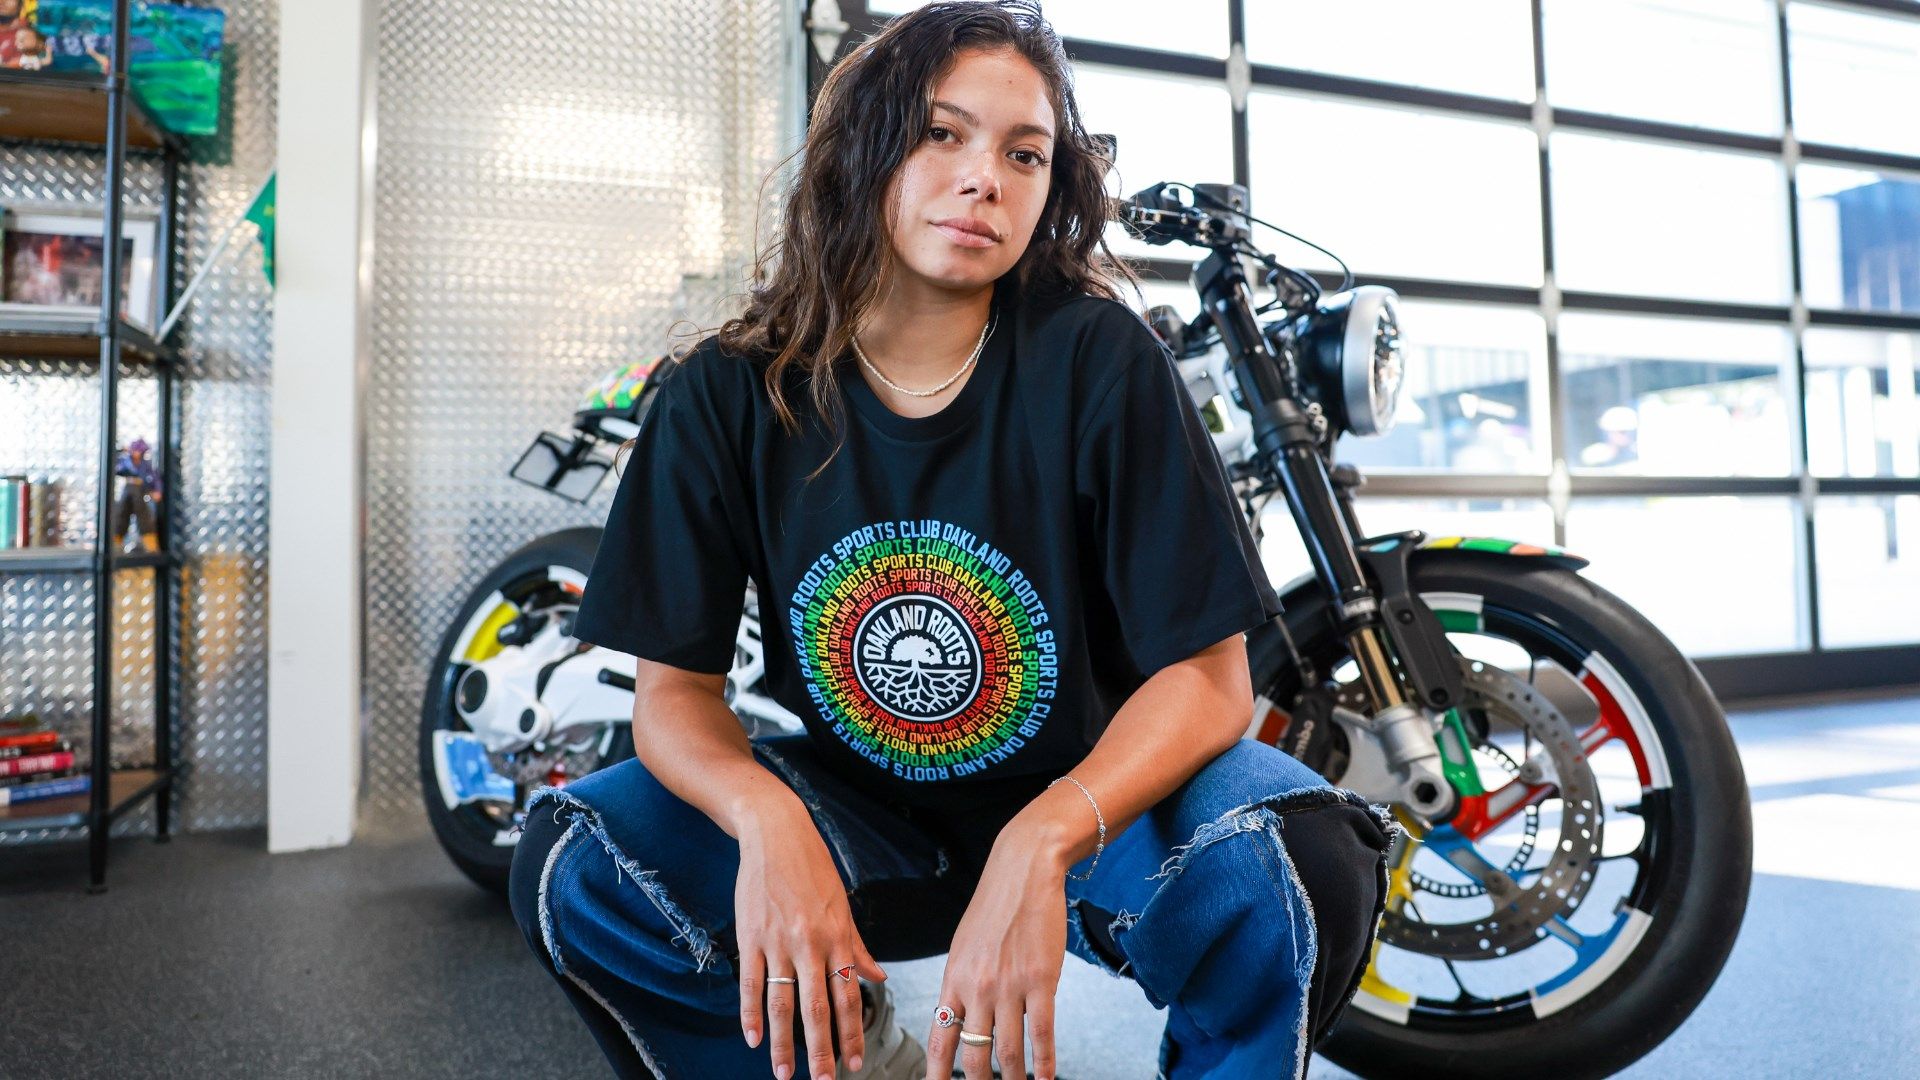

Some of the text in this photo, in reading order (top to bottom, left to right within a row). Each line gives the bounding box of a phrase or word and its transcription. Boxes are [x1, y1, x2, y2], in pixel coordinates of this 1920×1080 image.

[790, 520, 1057, 780] OAKLAND ROOTS SPORTS CLUB OAKLAND ROOTS SPORTS CLUB OAKLAND ROOTS SPORTS CLUB
[804, 538, 1038, 766] OAKLAND ROOTS SPORTS CLUB OAKLAND ROOTS SPORTS CLUB OAKLAND ROOTS SPORTS CLUB
[816, 554, 1023, 755] OAKLAND ROOTS SPORTS CLUB OAKLAND ROOTS SPORTS CLUB OAKLAND ROOTS SPORTS CLUB
[829, 569, 1008, 743] OAKLAND ROOTS SPORTS CLUB OAKLAND ROOTS SPORTS CLUB OAKLAND ROOTS SPORTS CLUB
[841, 582, 995, 732] OAKLAND ROOTS SPORTS CLUB OAKLAND ROOTS SPORTS CLUB OAKLAND ROOTS SPORTS CLUB
[863, 605, 970, 665] OAKLAND ROOTS
